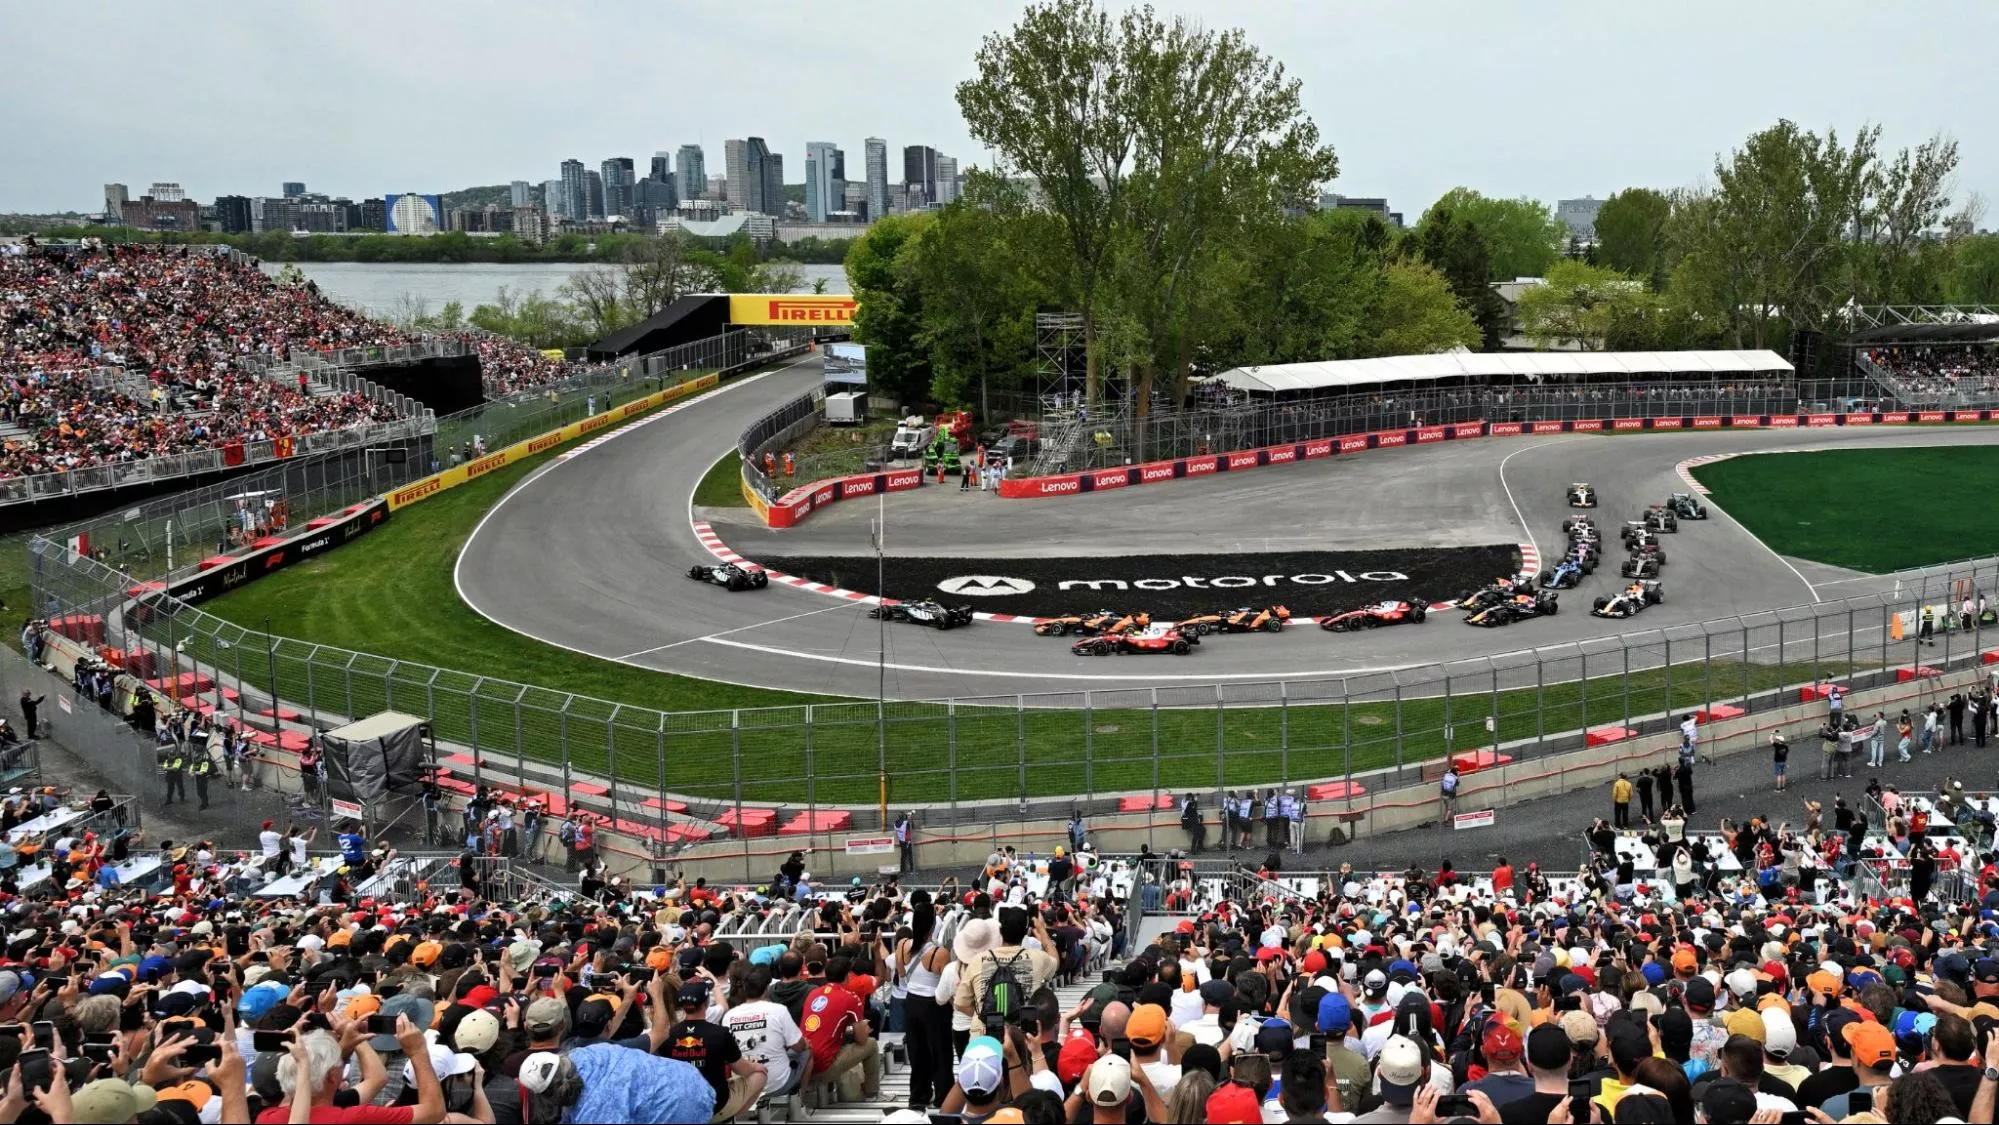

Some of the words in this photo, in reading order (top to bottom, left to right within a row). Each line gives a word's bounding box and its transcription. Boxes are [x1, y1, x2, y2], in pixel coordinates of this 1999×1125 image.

[624, 400, 649, 415] PIRELLI
[580, 414, 608, 432] PIRELLI
[1535, 423, 1560, 431] Lenovo
[1574, 421, 1600, 429] Lenovo
[1616, 420, 1640, 428] Lenovo
[1655, 419, 1680, 427] Lenovo
[1695, 418, 1720, 426] Lenovo
[1456, 427, 1480, 436] Lenovo
[1494, 424, 1520, 433] Lenovo
[1380, 434, 1404, 444] Lenovo
[1418, 430, 1443, 440] Lenovo
[528, 432, 561, 453] PIRELLI
[1341, 439, 1366, 450] Lenovo
[1307, 444, 1330, 456] Lenovo
[1230, 456, 1256, 467] Lenovo
[1270, 451, 1294, 461] Lenovo
[468, 453, 506, 477] PIRELLI
[1188, 462, 1215, 473] Lenovo
[1144, 468, 1172, 480] Lenovo
[888, 476, 919, 487] Lenovo
[1042, 480, 1078, 492] Lenovo
[1096, 475, 1126, 486] Lenovo
[394, 478, 440, 505] PIRELLI
[844, 481, 873, 494] Lenovo
[816, 490, 832, 504] Lenovo
[794, 502, 810, 518] Lenovo
[302, 539, 324, 552] Formula
[1058, 570, 1410, 590] motorola
[744, 1021, 765, 1030] CREW
